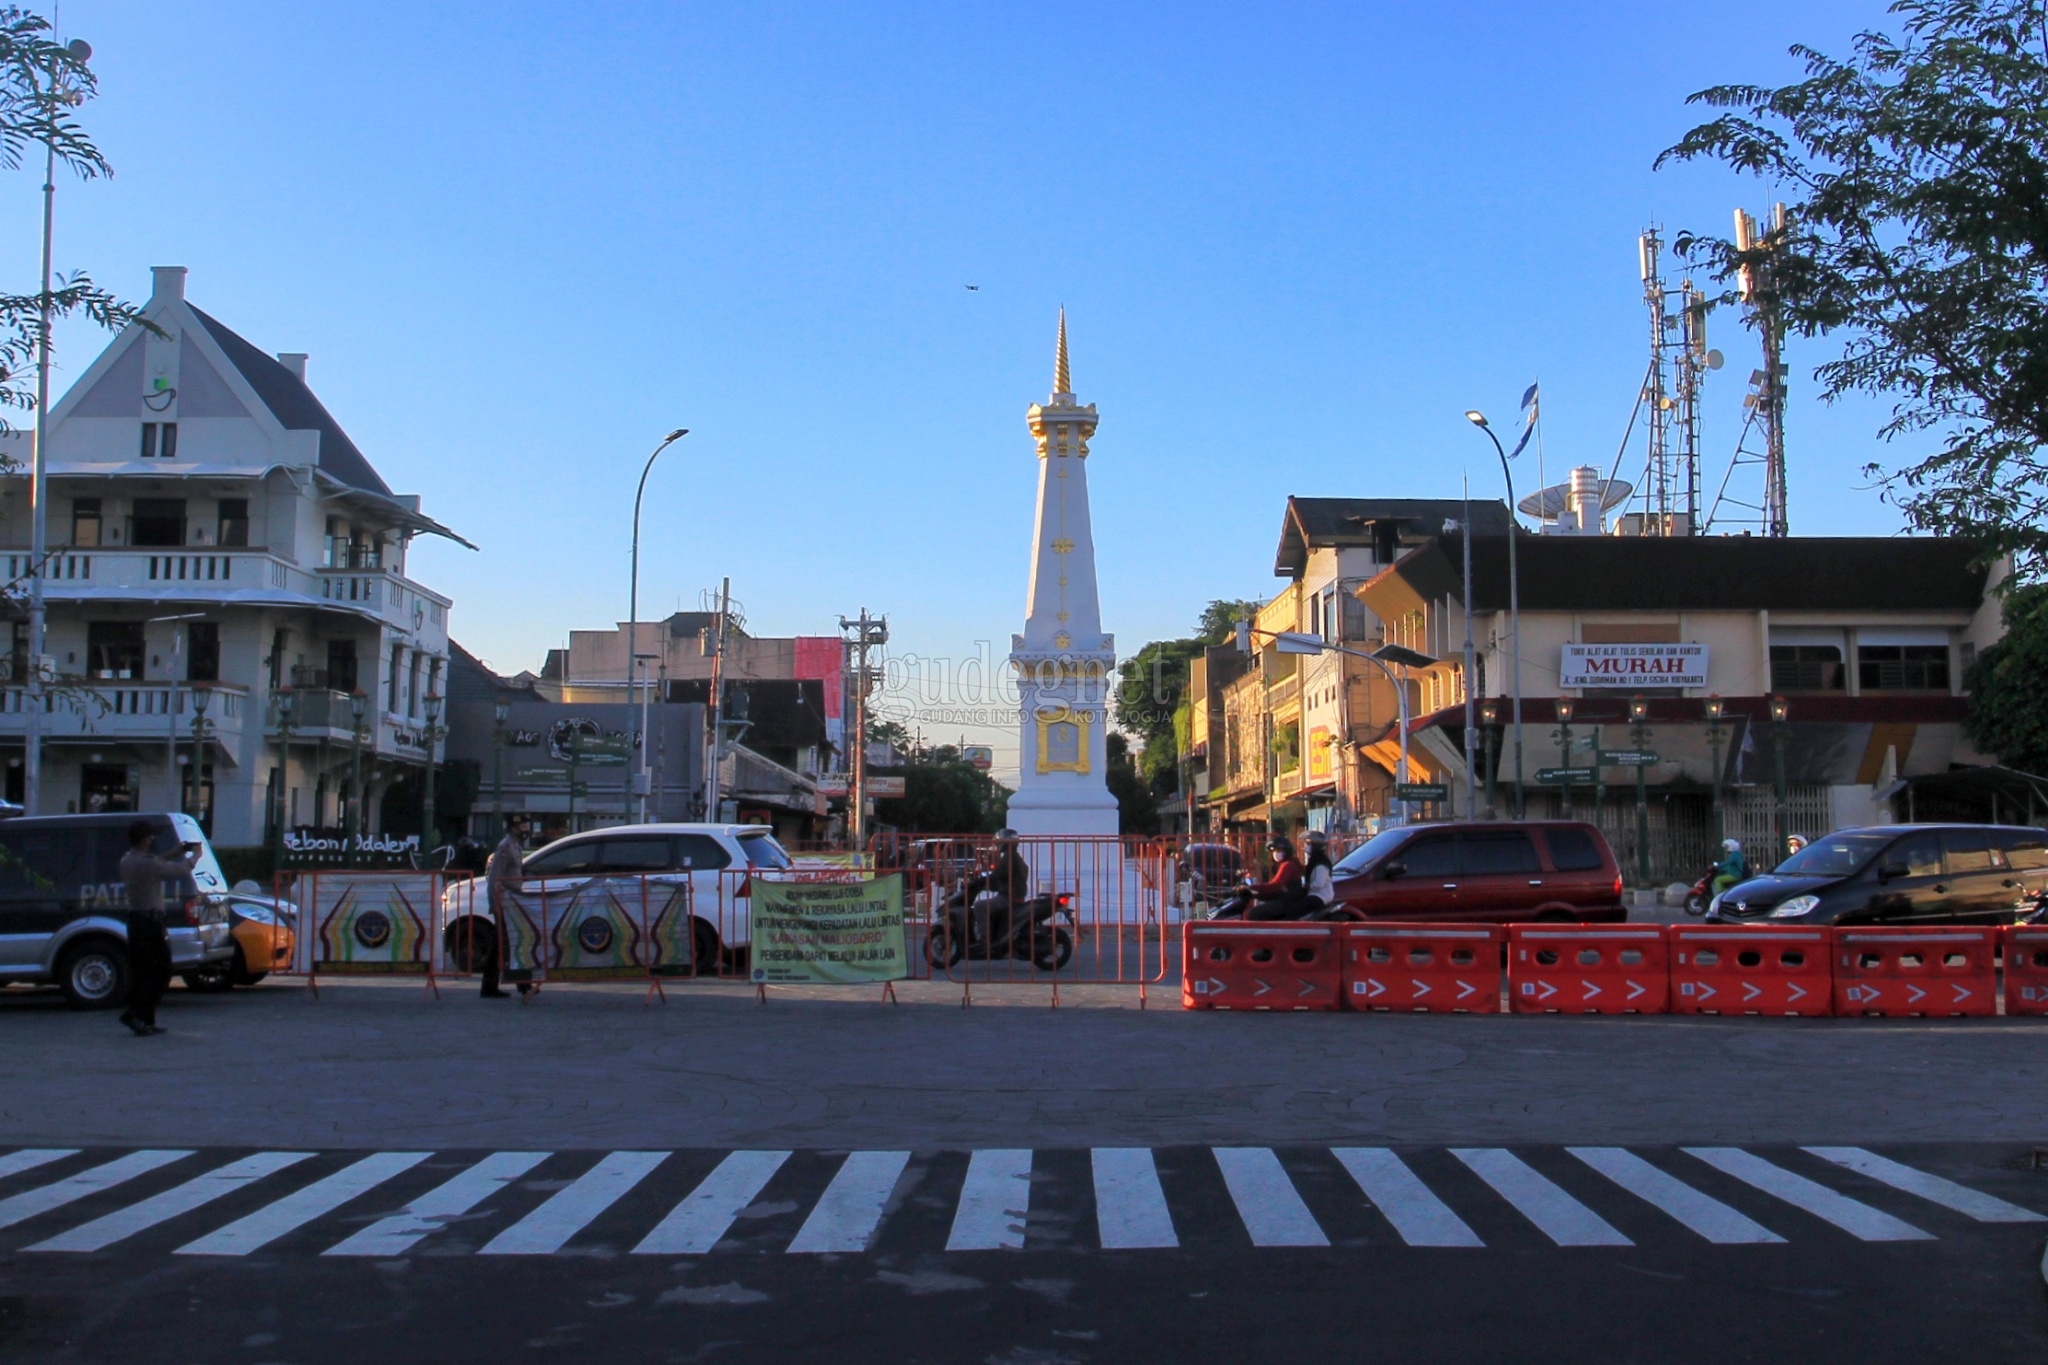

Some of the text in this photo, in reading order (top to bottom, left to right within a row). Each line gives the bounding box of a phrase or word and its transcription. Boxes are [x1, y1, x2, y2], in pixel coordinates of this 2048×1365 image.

[1638, 648, 1664, 656] SEKOLAH
[1666, 648, 1677, 656] DAN
[1680, 648, 1702, 656] KANTOR
[1584, 657, 1685, 674] MURAH
[80, 880, 182, 910] PATLI
[811, 903, 846, 915] REKAYASA
[847, 902, 864, 913] LALU
[865, 901, 887, 913] LINTAS
[819, 918, 859, 930] KEPADATAN
[859, 917, 877, 929] LALU
[877, 915, 901, 927] LINTAS
